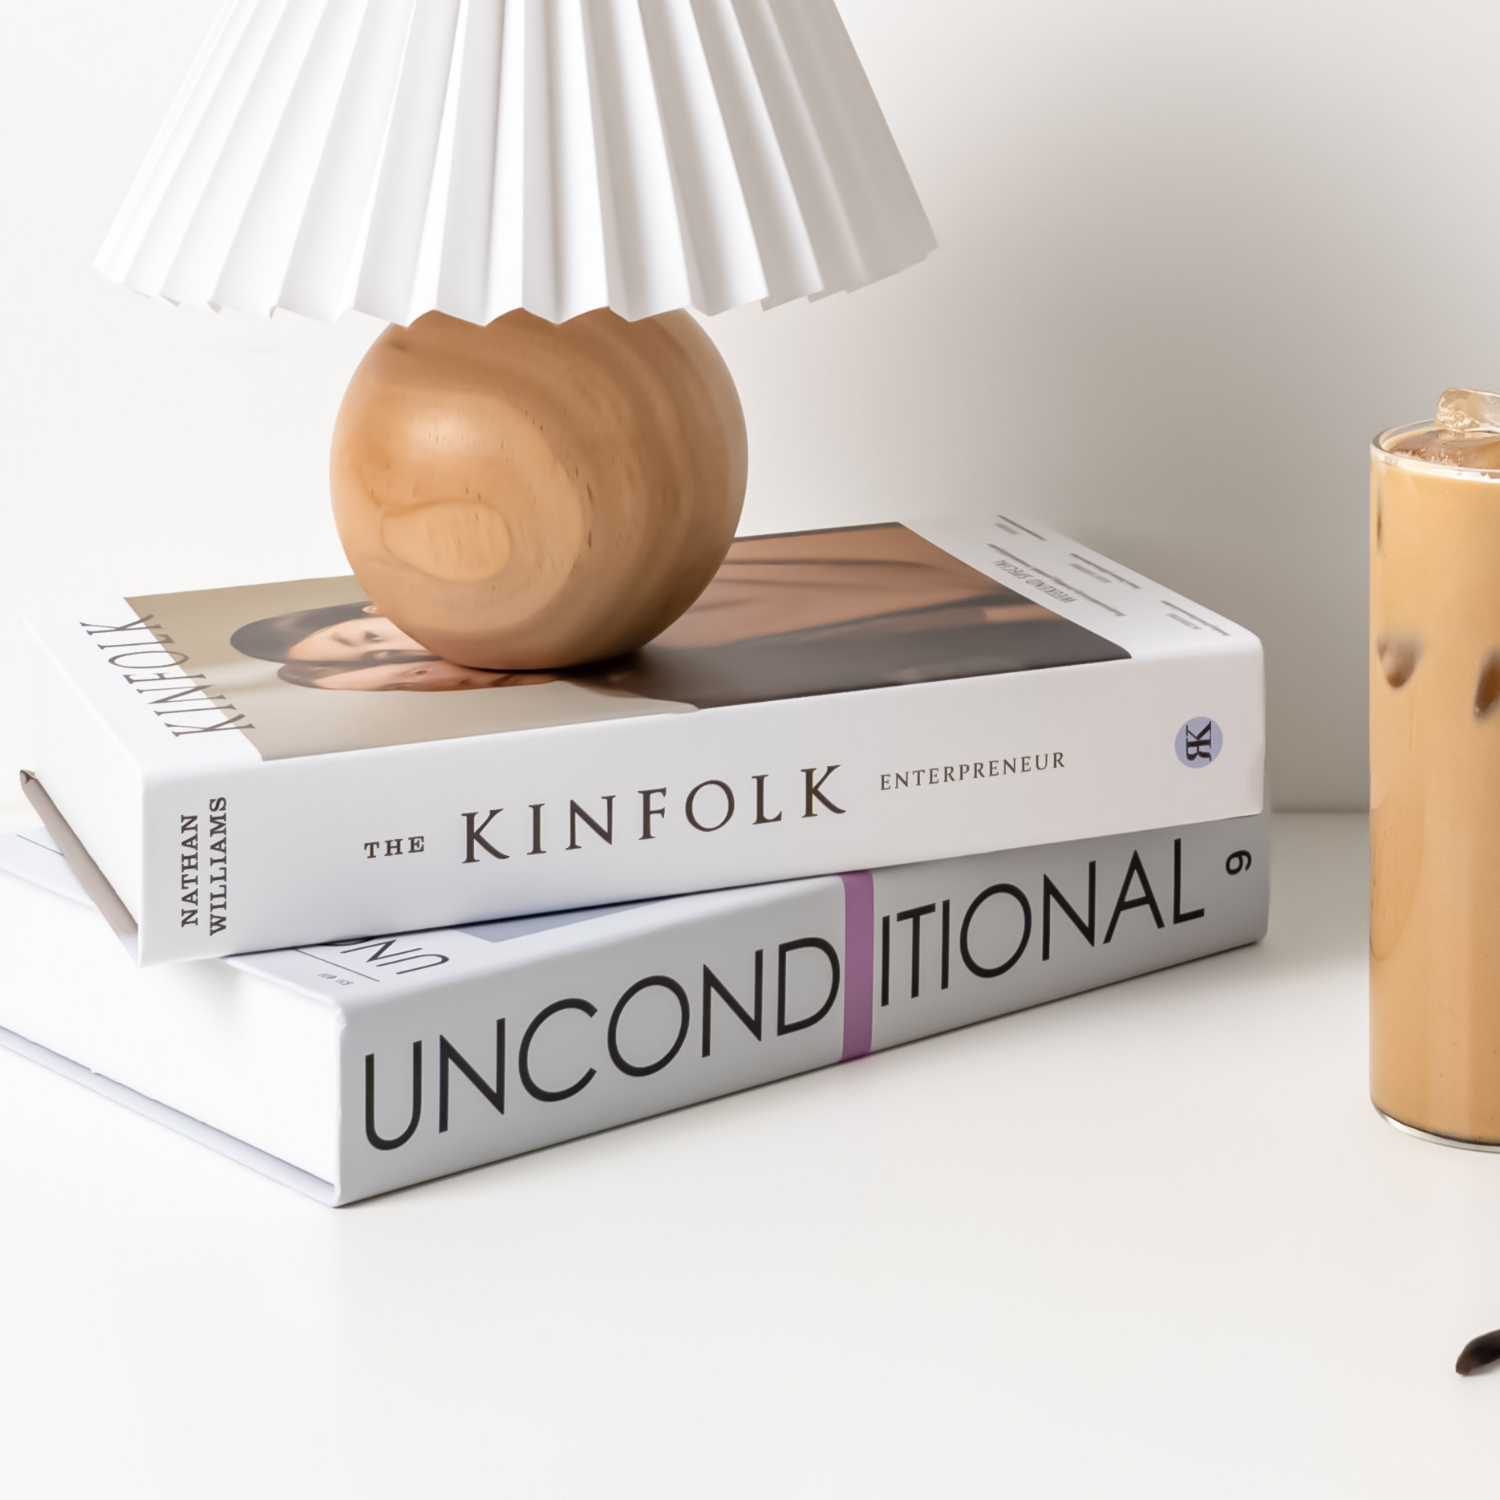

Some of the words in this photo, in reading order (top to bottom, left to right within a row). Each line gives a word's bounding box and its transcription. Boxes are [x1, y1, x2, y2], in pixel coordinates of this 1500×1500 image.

[80, 613, 255, 738] KINFOLK
[209, 796, 227, 936] WILLIAMS
[364, 835, 425, 859] THE
[461, 765, 846, 864] KINFOLK
[880, 751, 1066, 791] ENTERPRENEUR
[180, 814, 198, 928] NATHAN
